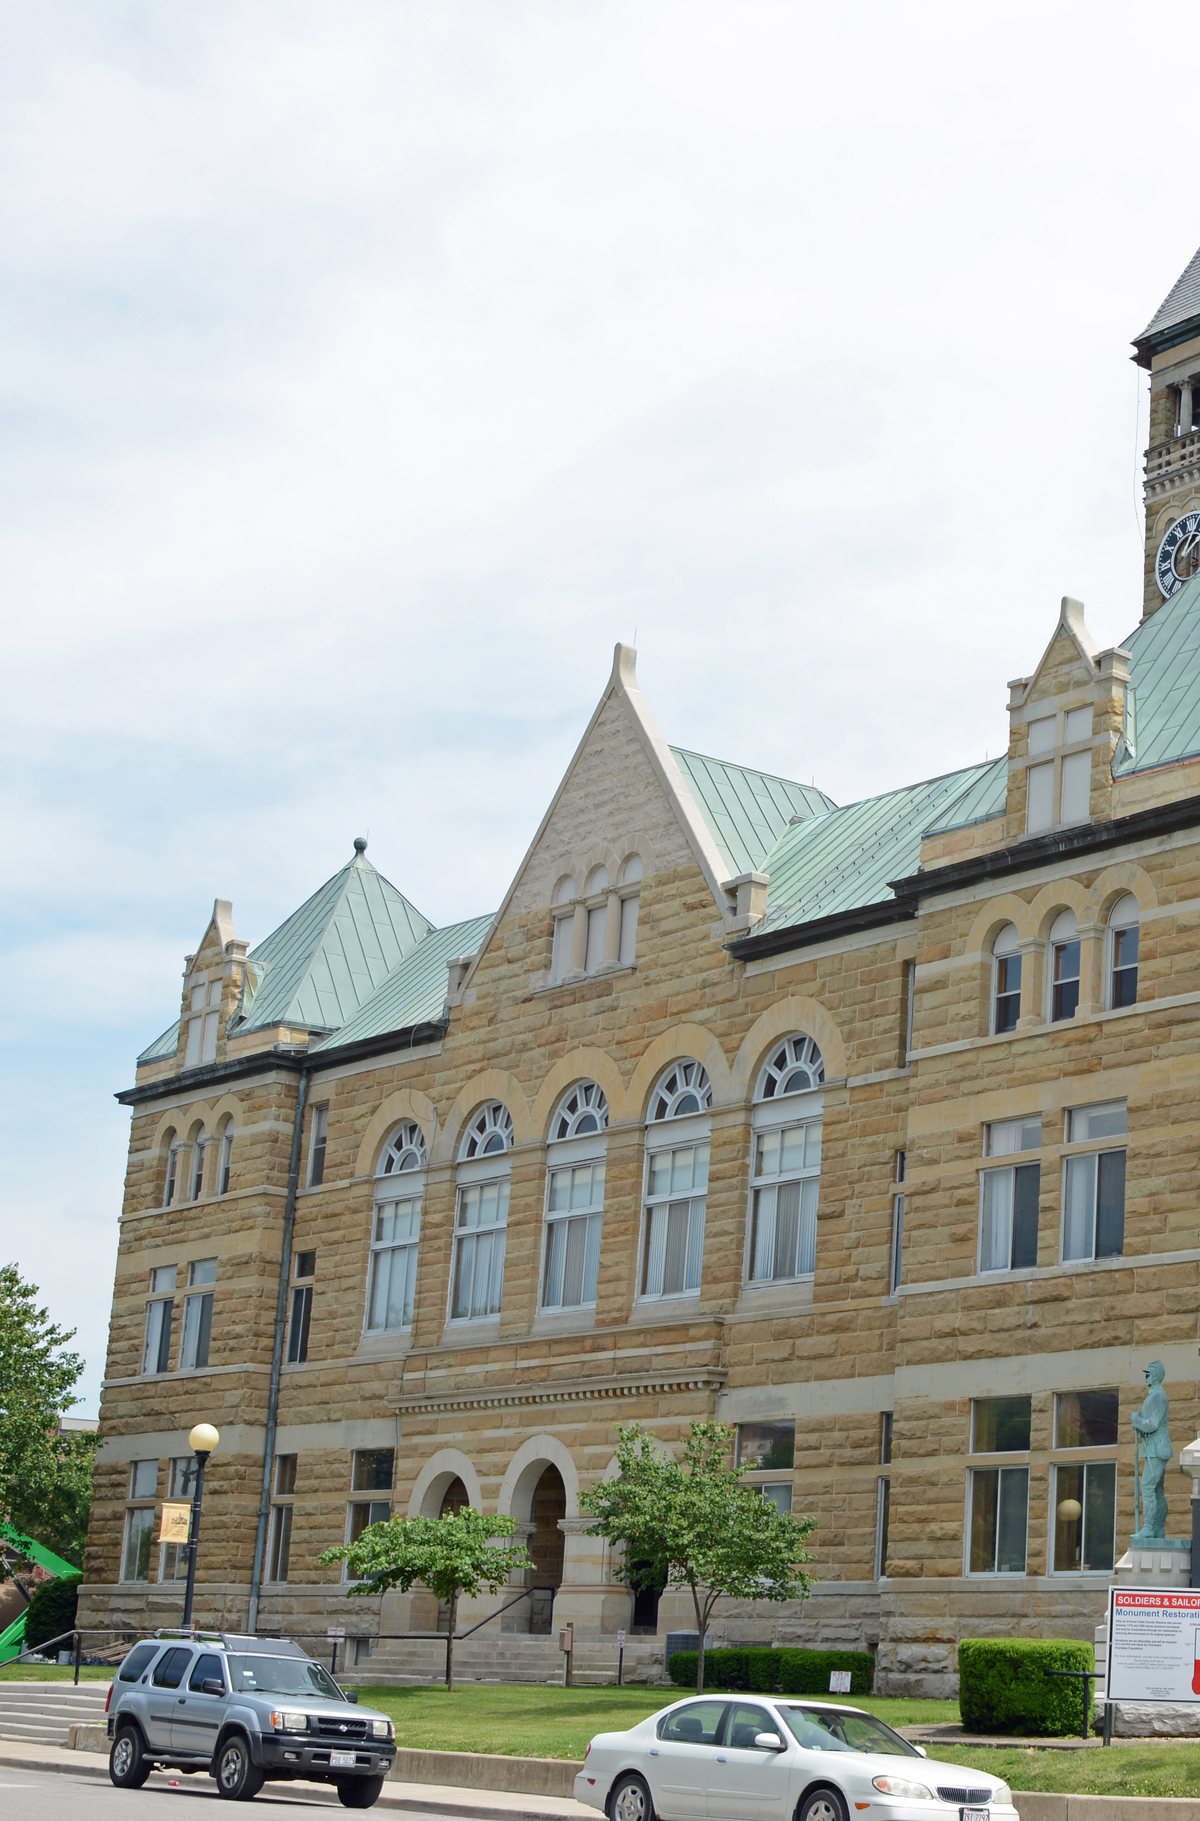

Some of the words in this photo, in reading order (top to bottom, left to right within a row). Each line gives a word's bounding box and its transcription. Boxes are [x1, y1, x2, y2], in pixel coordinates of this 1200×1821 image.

[1163, 544, 1175, 553] X
[1117, 1596, 1161, 1605] SOLDIERS
[1115, 1608, 1160, 1617] Monument
